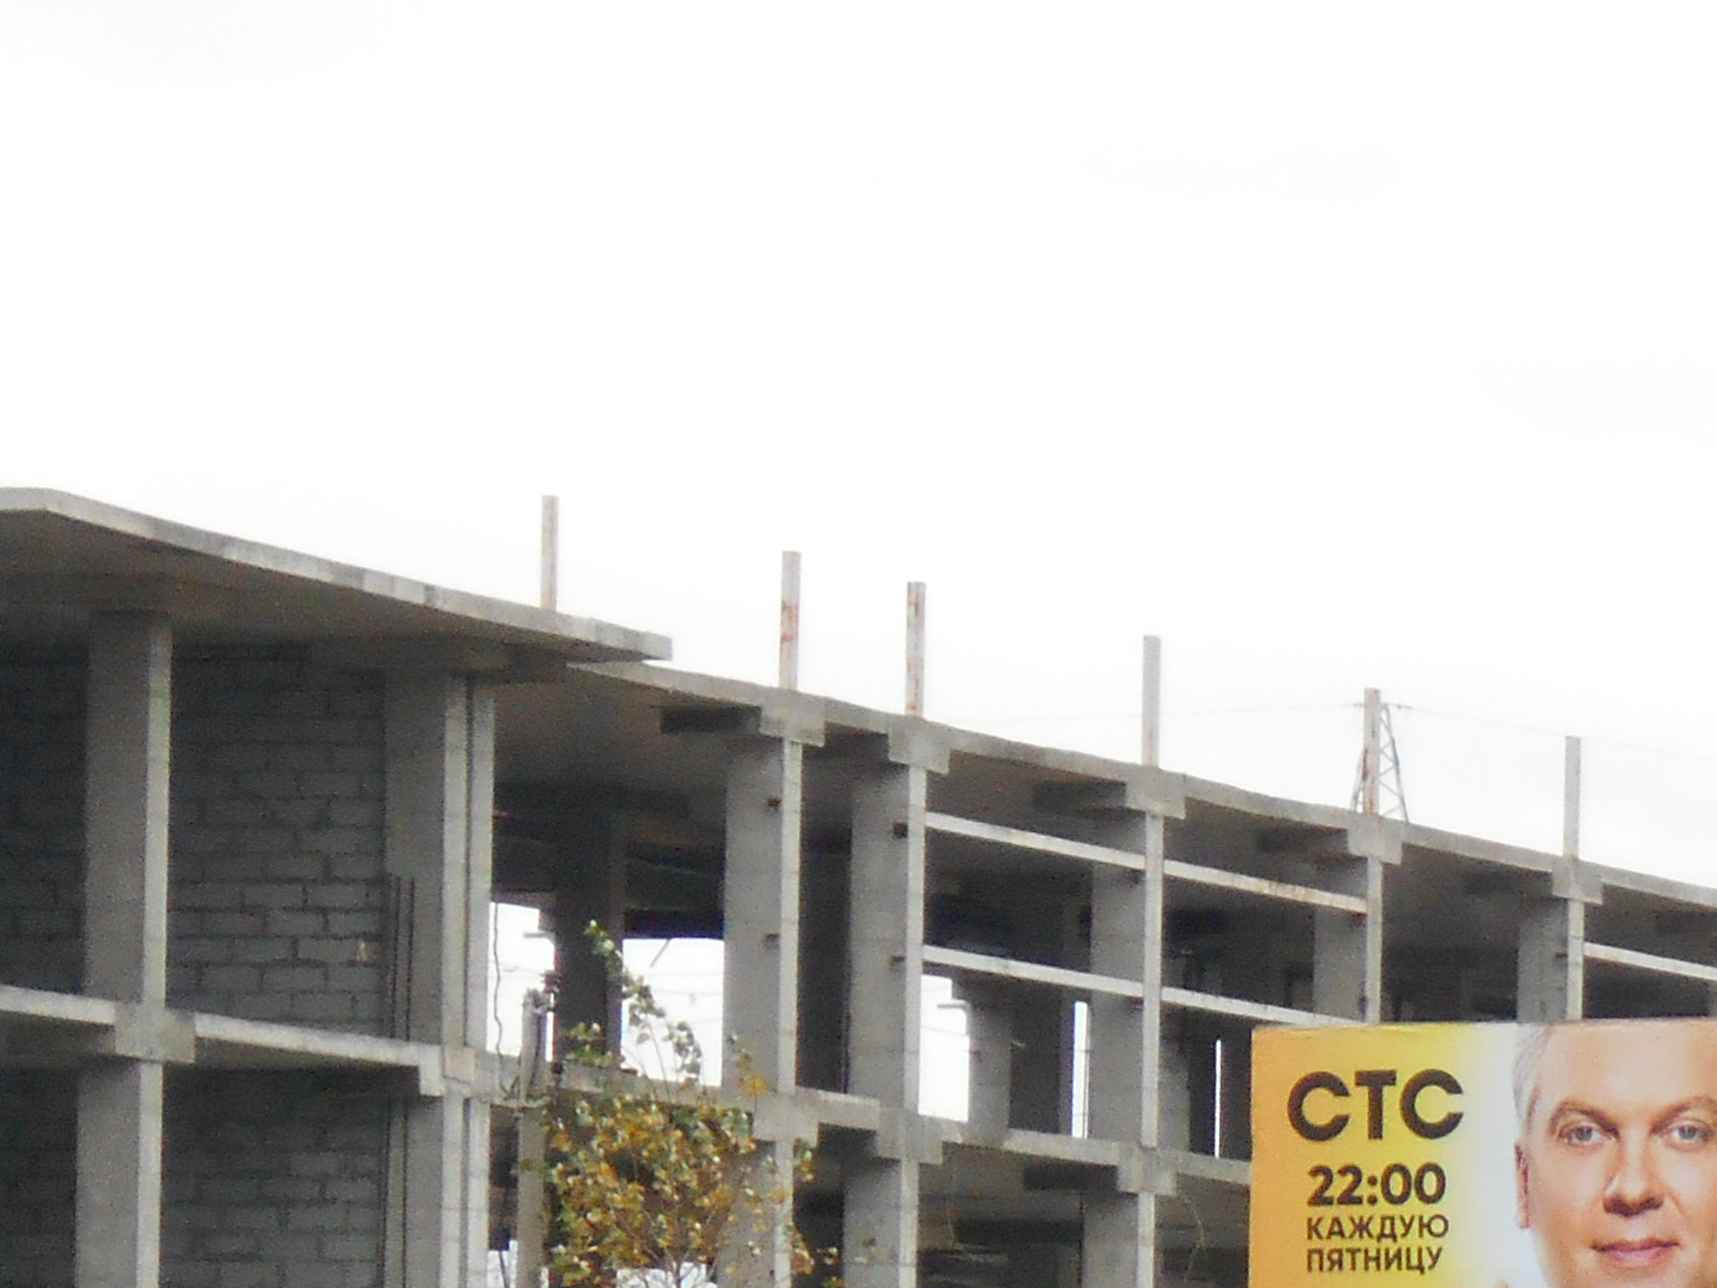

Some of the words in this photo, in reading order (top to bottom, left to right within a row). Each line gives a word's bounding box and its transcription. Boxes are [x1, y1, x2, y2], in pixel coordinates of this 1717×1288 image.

[1287, 1069, 1464, 1142] СТС
[1307, 1162, 1446, 1207] 22:00
[1306, 1214, 1450, 1243] КАЖДУЮ
[1306, 1247, 1443, 1275] ПЯТНИЦУ
